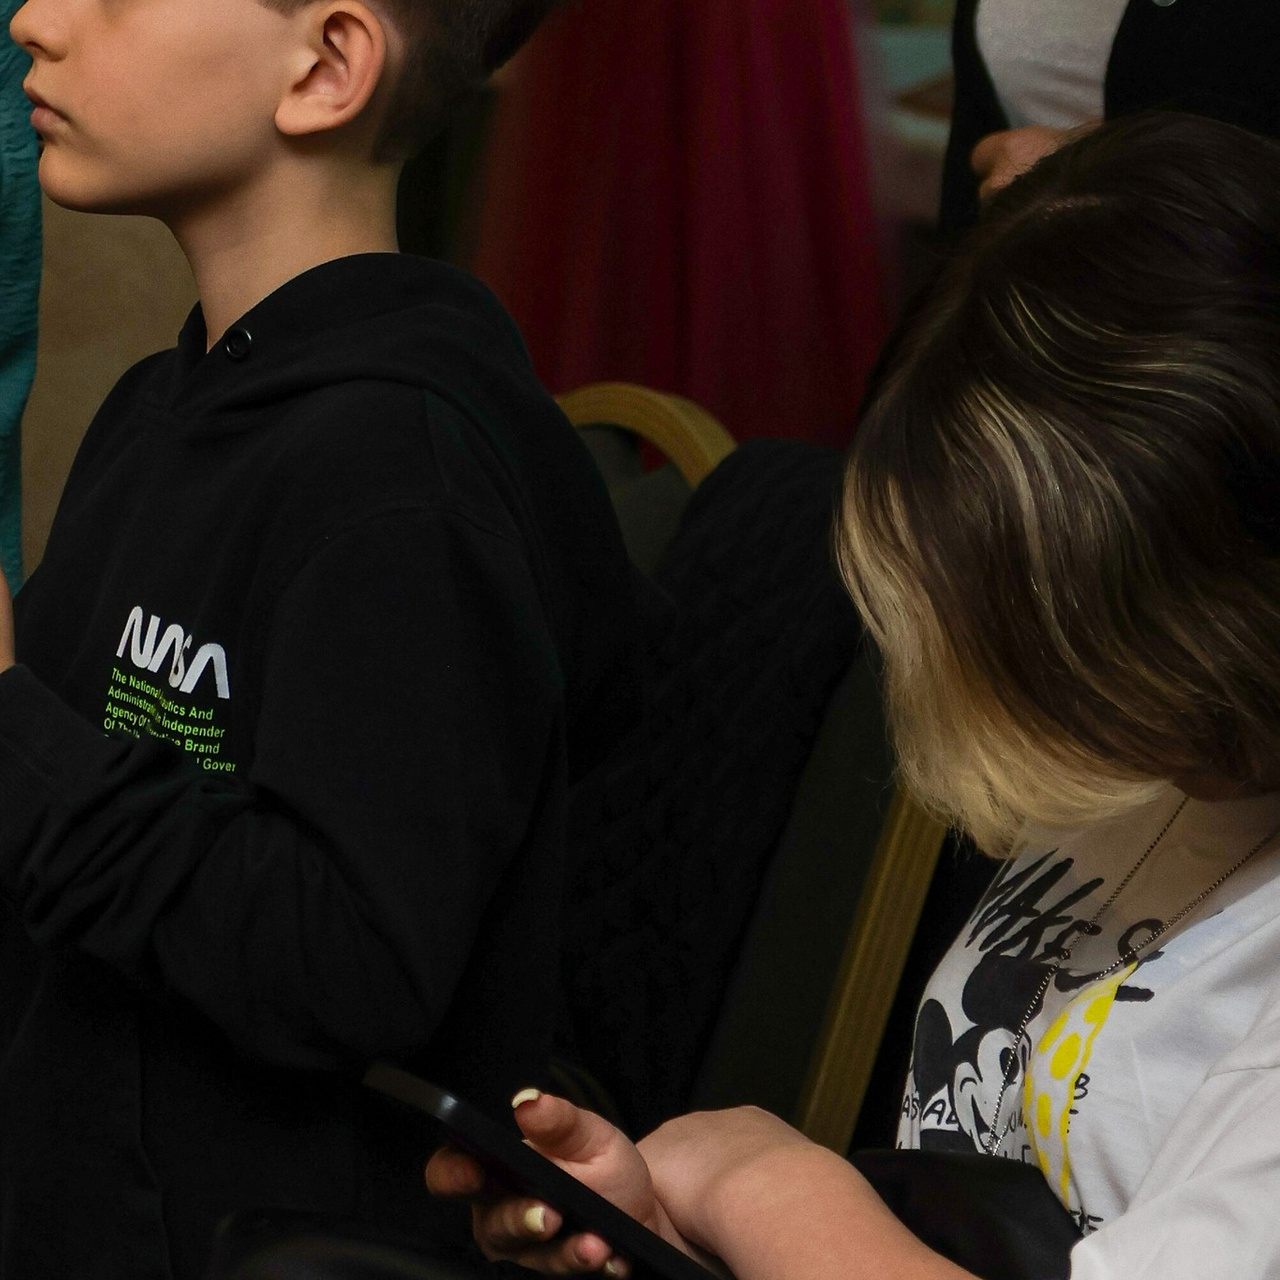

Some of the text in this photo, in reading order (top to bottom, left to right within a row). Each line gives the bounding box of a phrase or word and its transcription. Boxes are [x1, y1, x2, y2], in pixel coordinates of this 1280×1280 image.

[115, 605, 230, 699] NASA
[112, 667, 127, 685] The
[188, 706, 214, 721] And
[103, 717, 116, 731] Of
[105, 701, 138, 726] Agency
[184, 738, 221, 755] Brand
